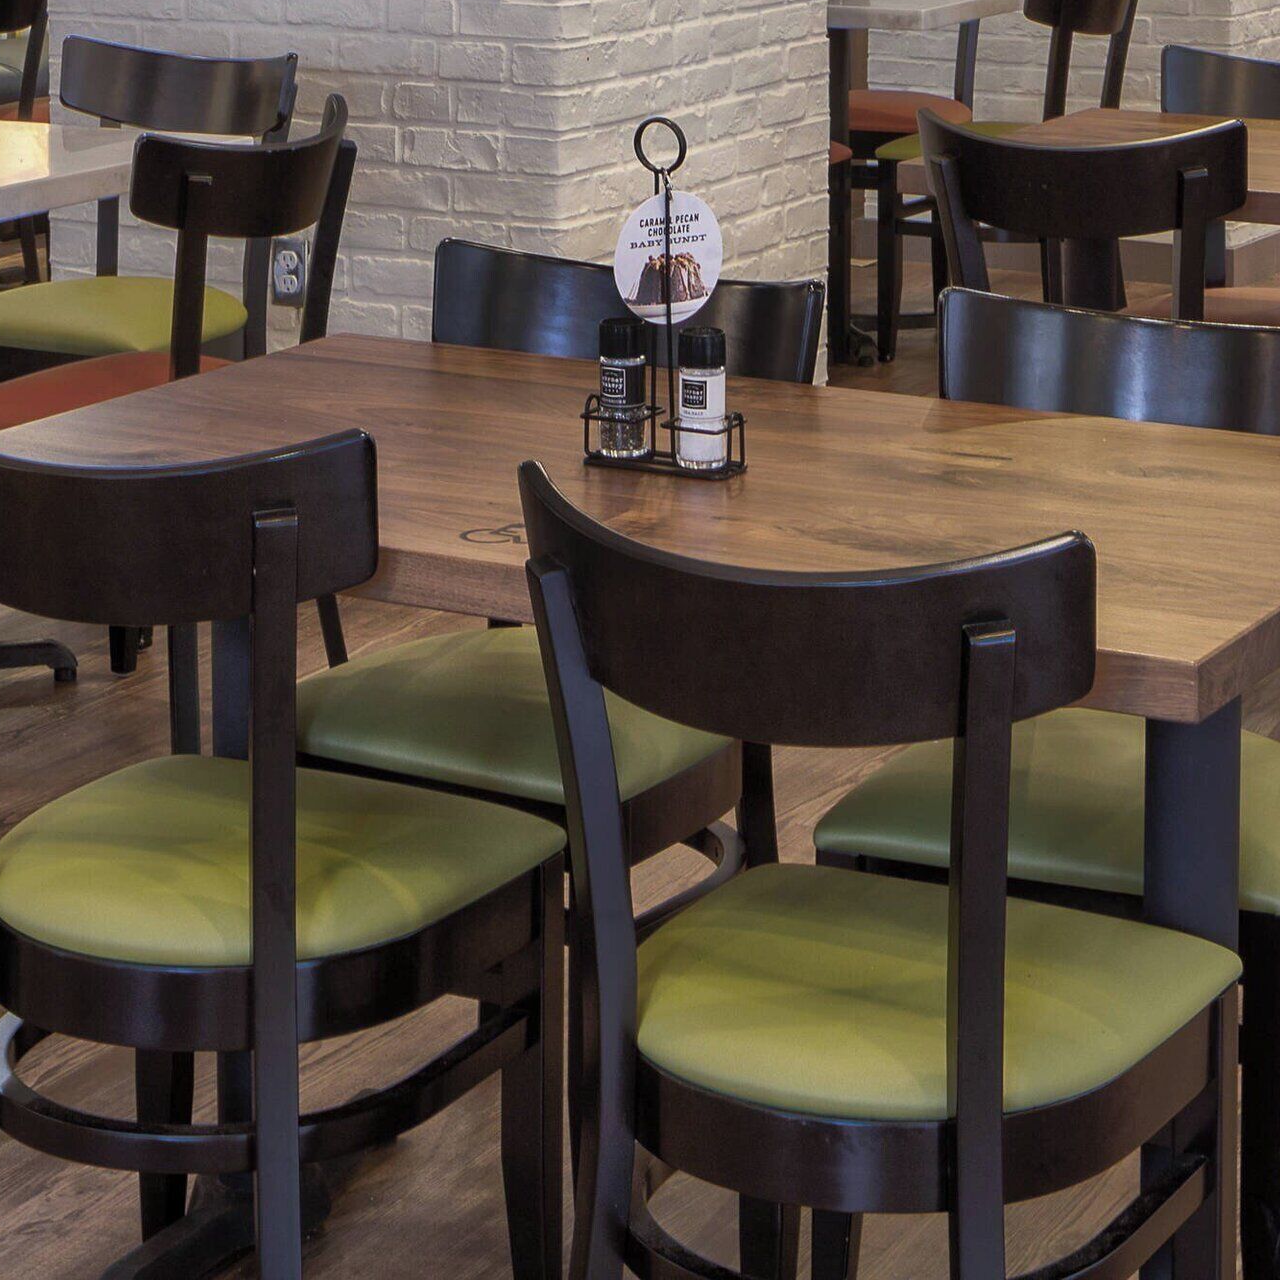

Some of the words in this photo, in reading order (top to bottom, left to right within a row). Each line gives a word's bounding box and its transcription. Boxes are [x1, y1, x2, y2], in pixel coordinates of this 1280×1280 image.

[639, 217, 673, 228] CARAML
[675, 213, 699, 224] PECAN
[648, 224, 690, 237] CHOOLATE
[630, 239, 663, 250] BABY
